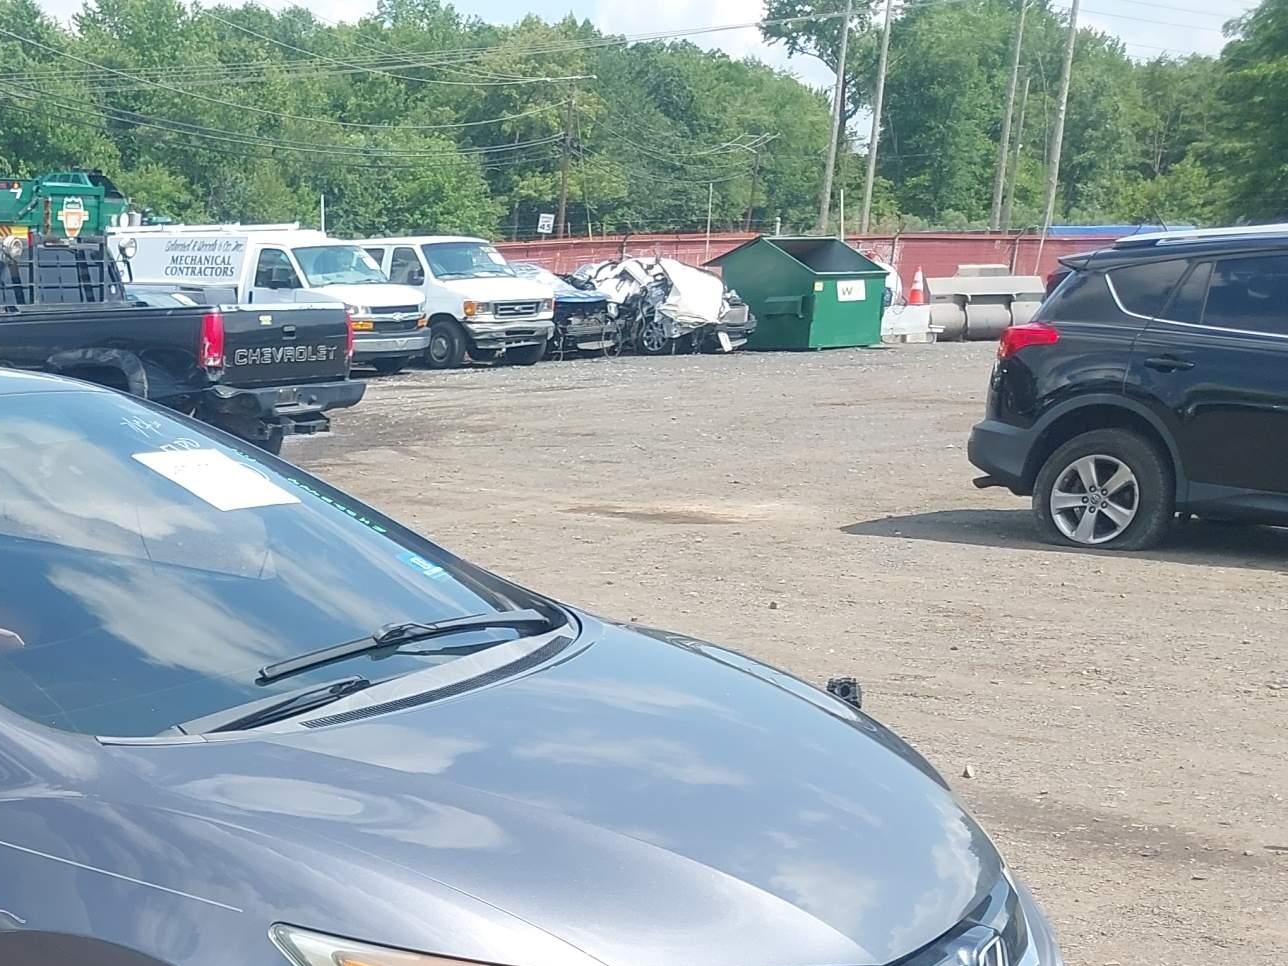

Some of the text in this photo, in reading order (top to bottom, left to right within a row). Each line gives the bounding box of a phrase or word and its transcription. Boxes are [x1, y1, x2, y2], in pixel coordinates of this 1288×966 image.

[539, 223, 552, 231] 45
[170, 255, 232, 266] MECHANICAL
[164, 266, 235, 277] CONTRACTORS
[841, 287, 853, 296] W
[234, 345, 338, 366] CHEVROLET
